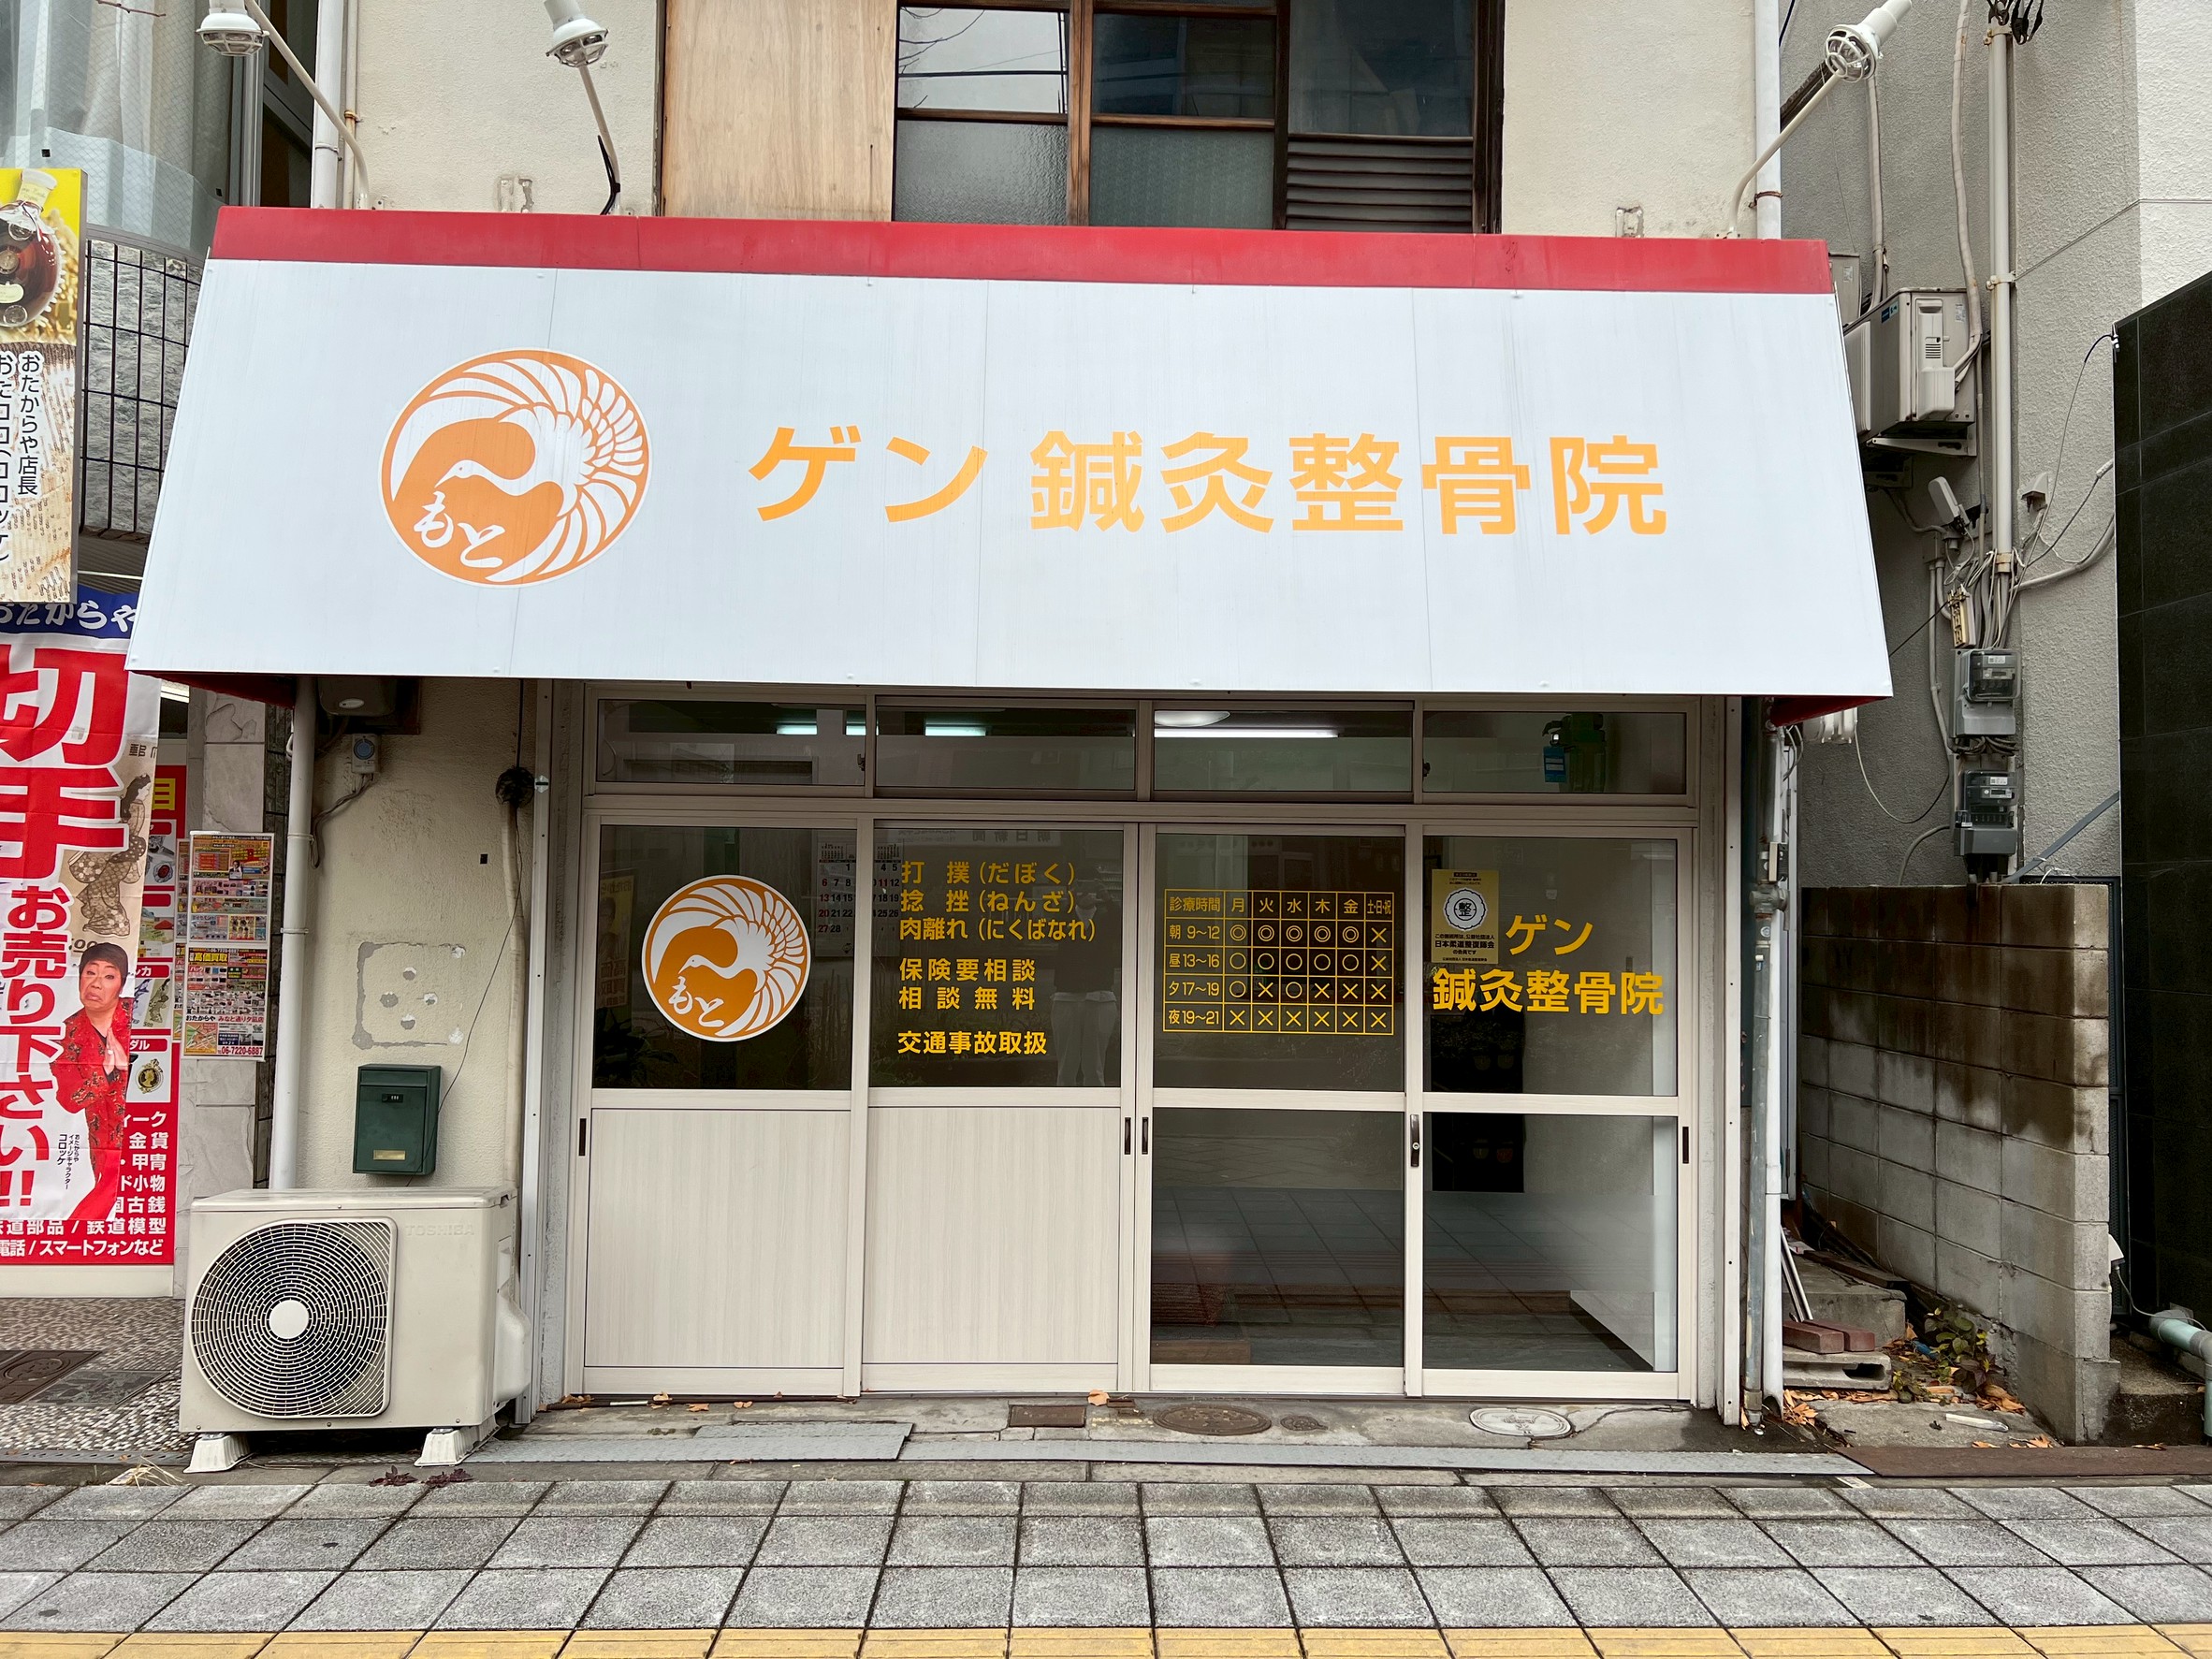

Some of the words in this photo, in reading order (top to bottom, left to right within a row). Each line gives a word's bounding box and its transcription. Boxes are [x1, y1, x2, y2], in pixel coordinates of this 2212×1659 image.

[18, 354, 41, 496] おたからや店長
[747, 424, 989, 523] ゲン
[1028, 429, 1668, 536] 鍼灸整骨院
[412, 492, 505, 568] もと
[1169, 896, 1221, 912] 診療時間
[1230, 898, 1245, 913] 月
[1259, 897, 1274, 913] 火
[1286, 898, 1302, 913] 水
[1314, 898, 1331, 913] 木
[1343, 898, 1359, 914] 金
[1169, 924, 1182, 940] 朝
[1506, 913, 1594, 956] ゲン
[898, 957, 1036, 982] 保険要相談
[667, 975, 725, 1027] もと
[898, 986, 1036, 1011] 相談無料
[1432, 968, 1665, 1016] 鍼灸整骨院
[896, 1030, 1048, 1055] 交通事故取扱
[56, 1133, 67, 1166] コロッケ
[0, 1220, 65, 1236] 道部品
[404, 1224, 474, 1236] TOSHIBA
[39, 1239, 164, 1257] スマートフォンなど
